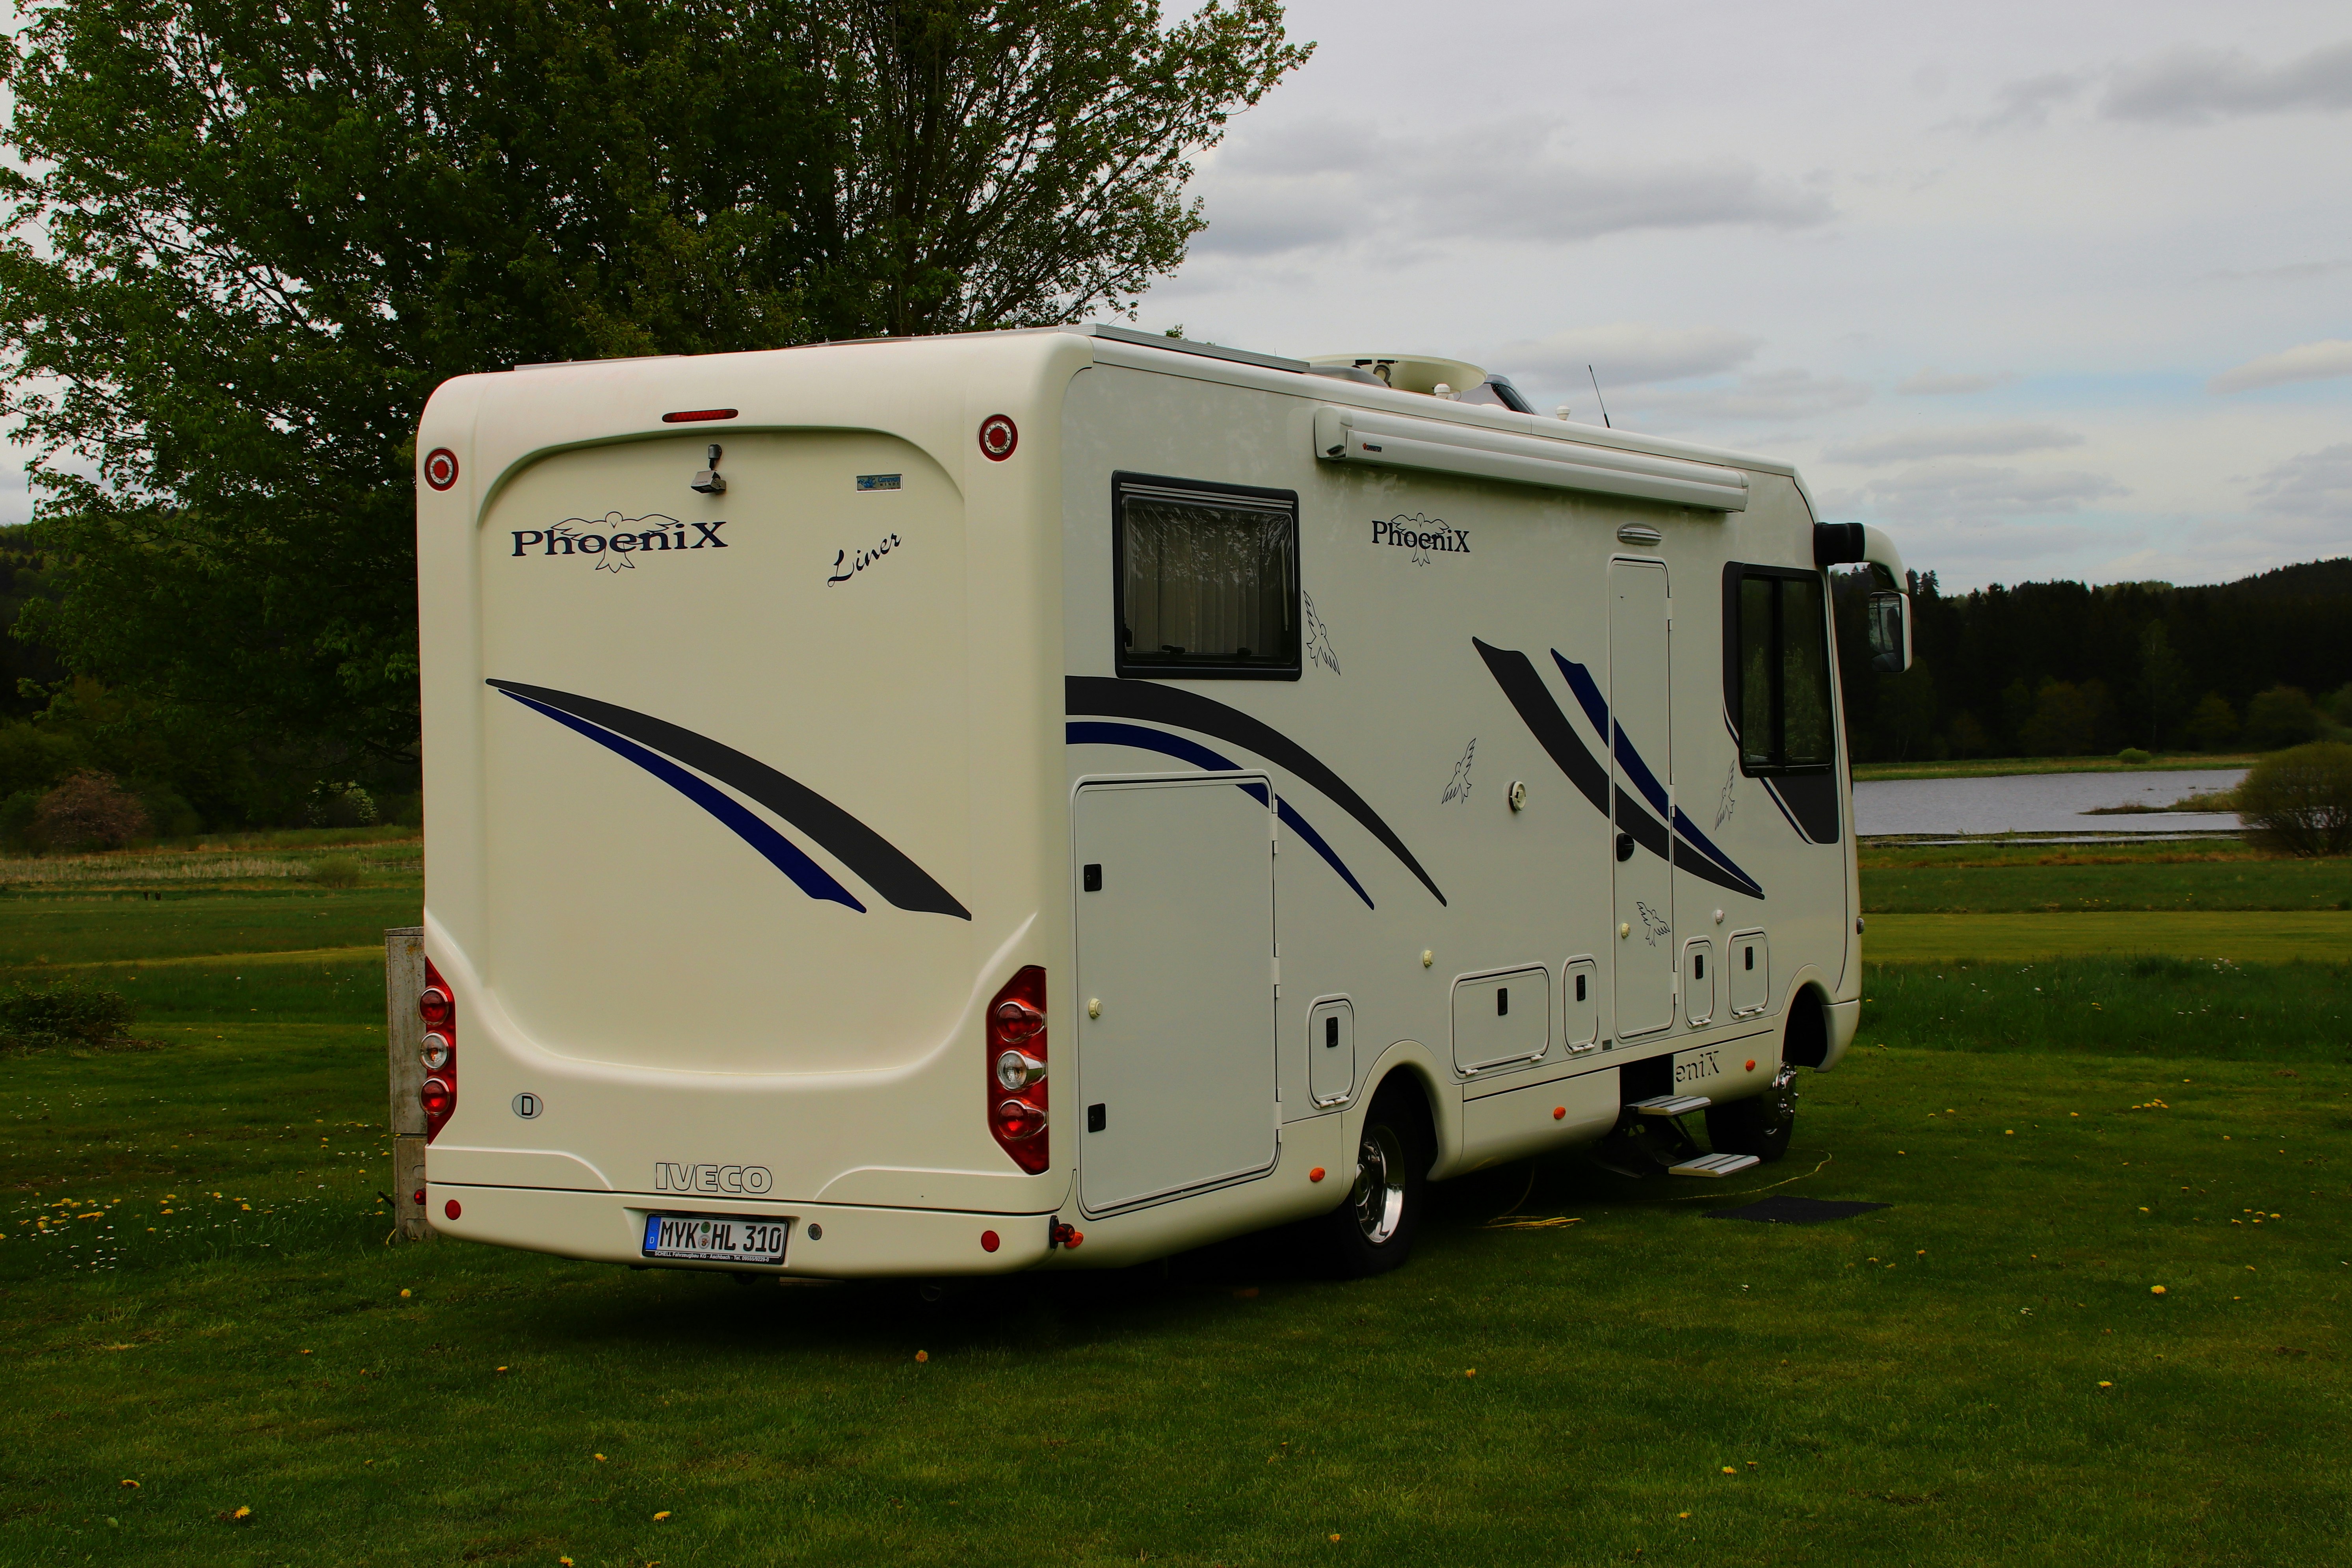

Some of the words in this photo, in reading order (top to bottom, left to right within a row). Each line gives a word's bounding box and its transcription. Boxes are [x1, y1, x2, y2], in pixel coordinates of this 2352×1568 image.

[511, 521, 728, 556] PhoeniX
[1372, 520, 1470, 553] PhoeniX
[827, 533, 902, 587] Liner
[522, 1095, 534, 1116] D
[656, 1162, 772, 1194] IVECO
[660, 1221, 699, 1248] MYK
[711, 1224, 736, 1250] HL
[743, 1226, 781, 1252] 310
